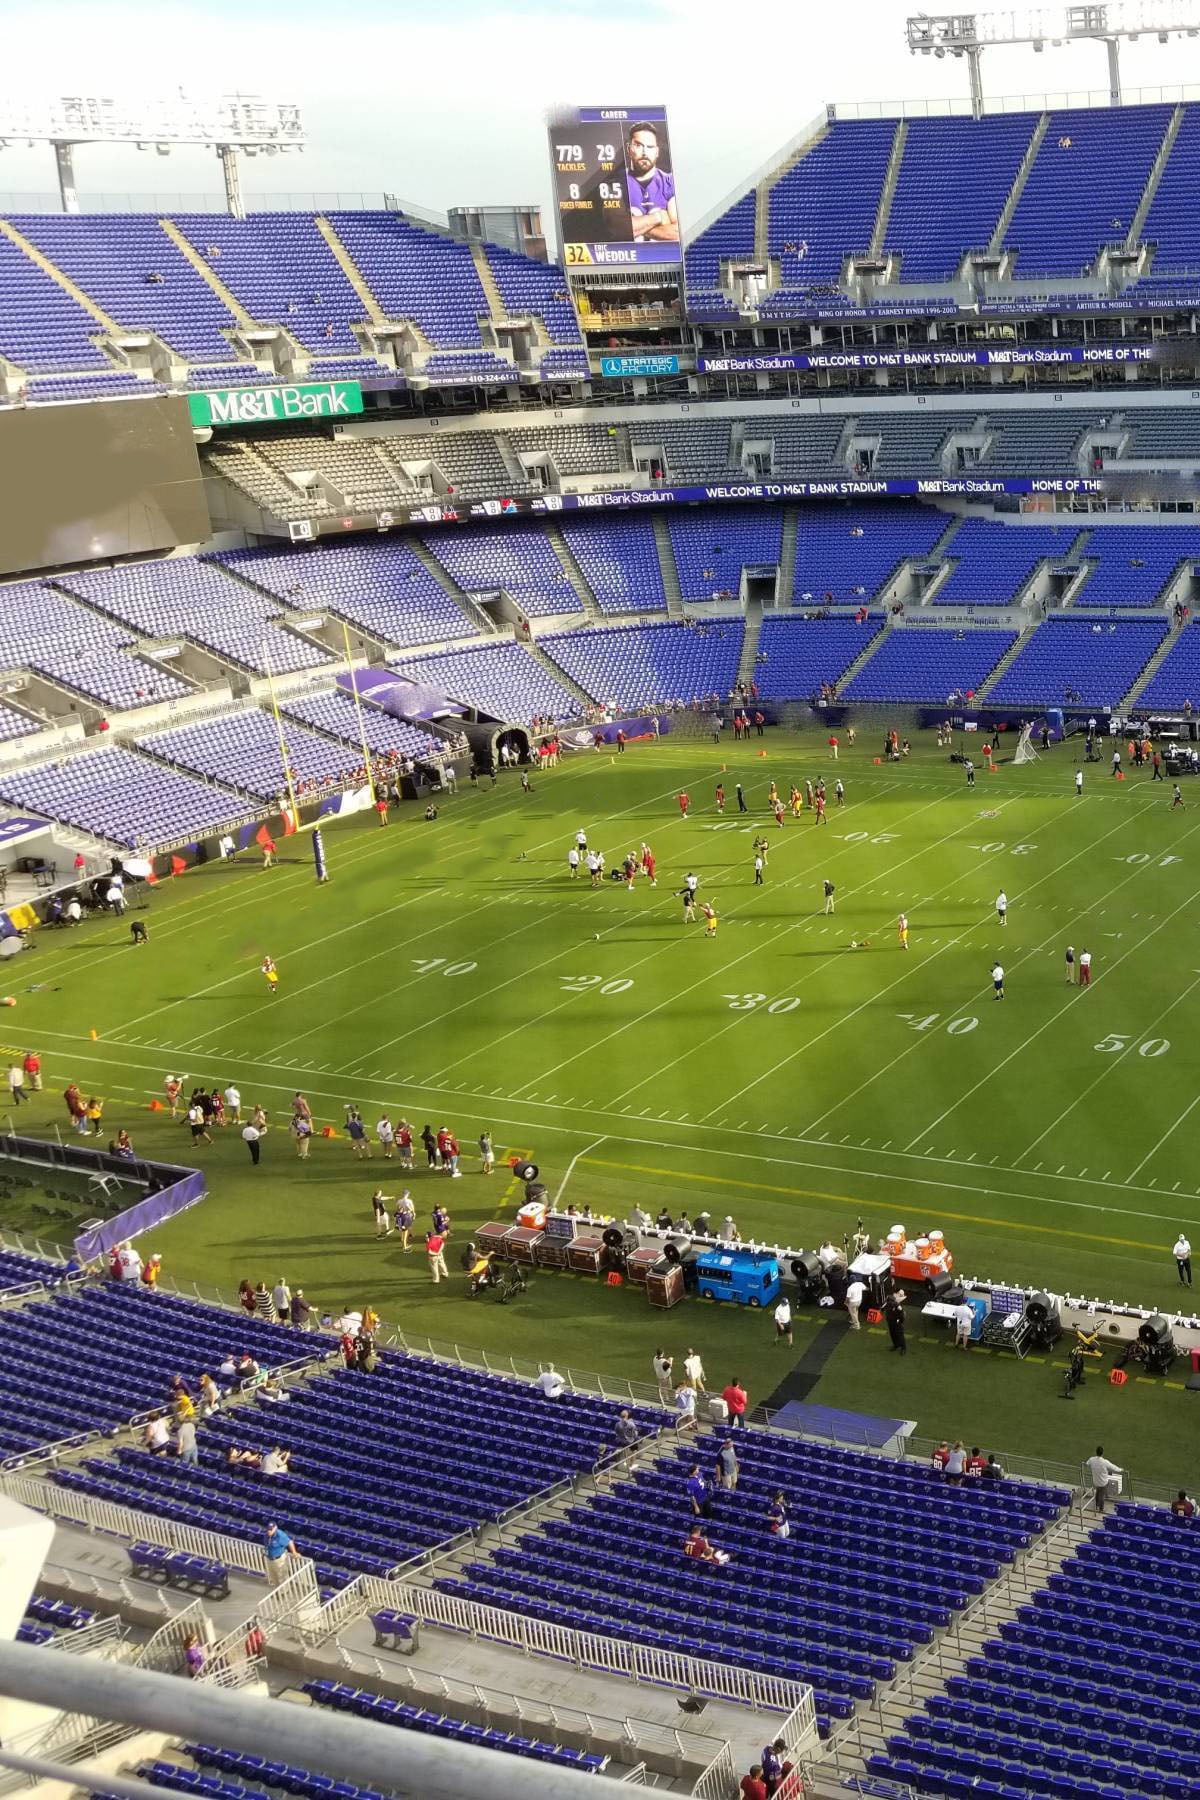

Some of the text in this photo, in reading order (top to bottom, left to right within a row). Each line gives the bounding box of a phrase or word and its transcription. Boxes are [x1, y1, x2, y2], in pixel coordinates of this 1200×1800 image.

[600, 111, 628, 119] CAREER
[556, 144, 615, 161] 779 29
[557, 162, 614, 171] TACKLES INT
[569, 182, 622, 199] 8 8.5
[604, 200, 621, 208] SACK
[568, 246, 584, 262] 32
[595, 250, 637, 262] WEDDLE
[1076, 301, 1133, 310] ARTHUR MODELL
[761, 311, 792, 319] SMYTH
[818, 309, 834, 317] RING
[835, 309, 843, 317] OF
[844, 308, 867, 316] HONOR
[808, 352, 976, 367] WELCOME TO M&T BANK STADIUM
[988, 350, 1072, 363] M&T Bank Stadium
[1083, 350, 1113, 360] HOME
[1115, 349, 1130, 360] OF
[621, 356, 673, 366] STRATEGIC
[704, 357, 795, 371] M&T Bank Stadium
[547, 371, 586, 379] RAVENS
[622, 364, 672, 374] FACTORY
[468, 374, 518, 383] 410-324-6141
[206, 385, 350, 423] M&T Bank
[705, 482, 887, 498] WELCOME TO M&T BANK STADIUM
[918, 480, 1004, 492] M&T Bank Stadium
[1032, 480, 1063, 491] HOME
[1065, 480, 1080, 491] OF
[577, 491, 674, 507] M&T Bank Stadium
[417, 958, 478, 976] 10
[560, 975, 634, 995] 20
[729, 992, 801, 1014] 30
[906, 1013, 979, 1035] 40
[1093, 1033, 1171, 1057] 50
[1112, 1371, 1122, 1383] 40
[933, 1458, 943, 1470] 80
